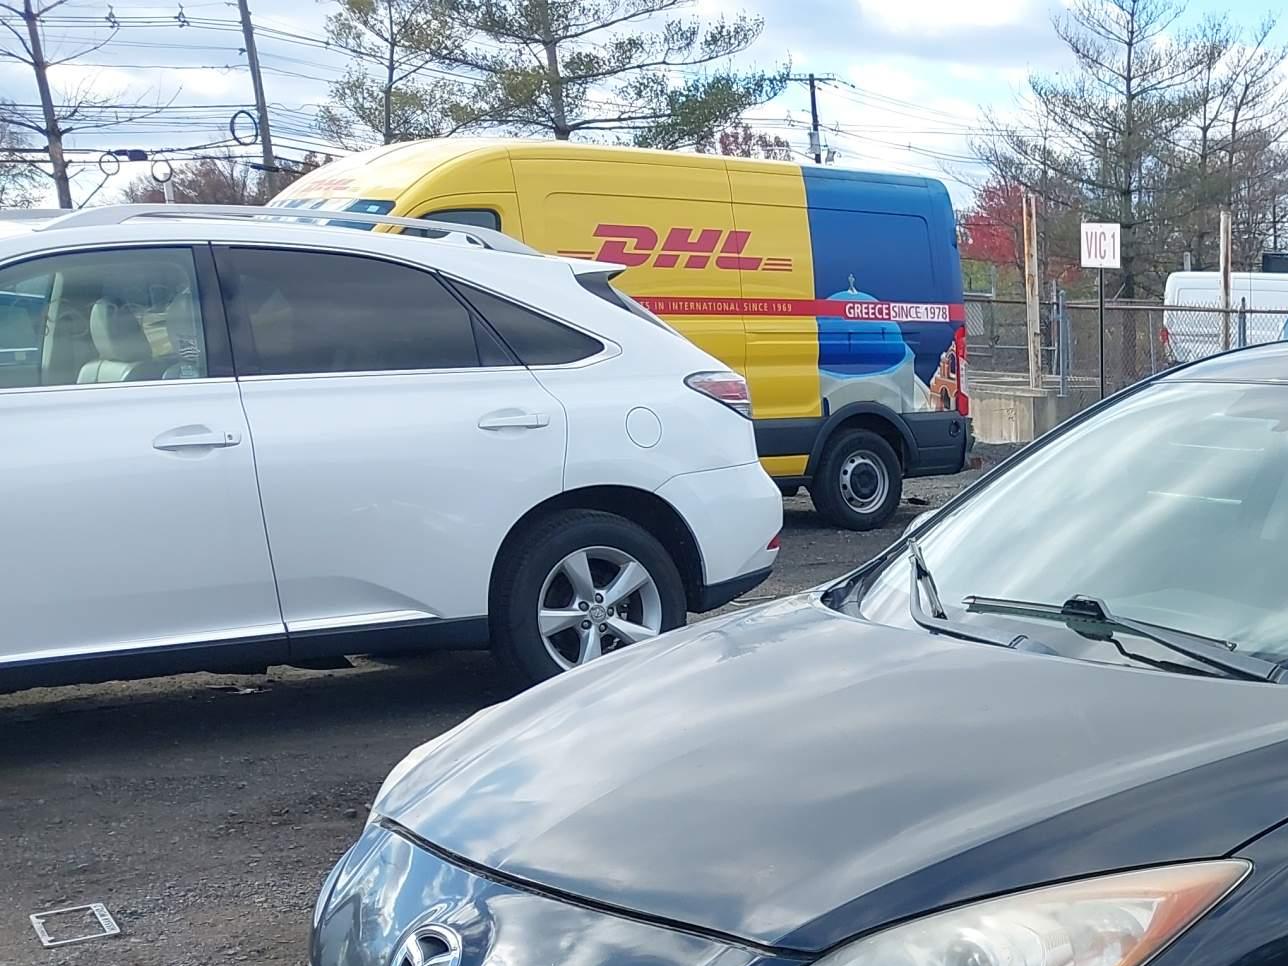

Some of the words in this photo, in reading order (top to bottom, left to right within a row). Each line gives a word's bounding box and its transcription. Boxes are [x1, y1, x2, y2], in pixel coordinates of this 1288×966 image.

[592, 223, 763, 270] DHL
[1085, 231, 1107, 260] VIC
[1111, 232, 1116, 259] 1
[654, 301, 665, 311] IN
[668, 301, 740, 312] INTERNATIONAL
[743, 302, 769, 312] SINCE
[772, 303, 792, 313] 1969
[845, 302, 889, 319] GREECE
[891, 304, 921, 320] SINCE
[924, 305, 949, 320] 1978
